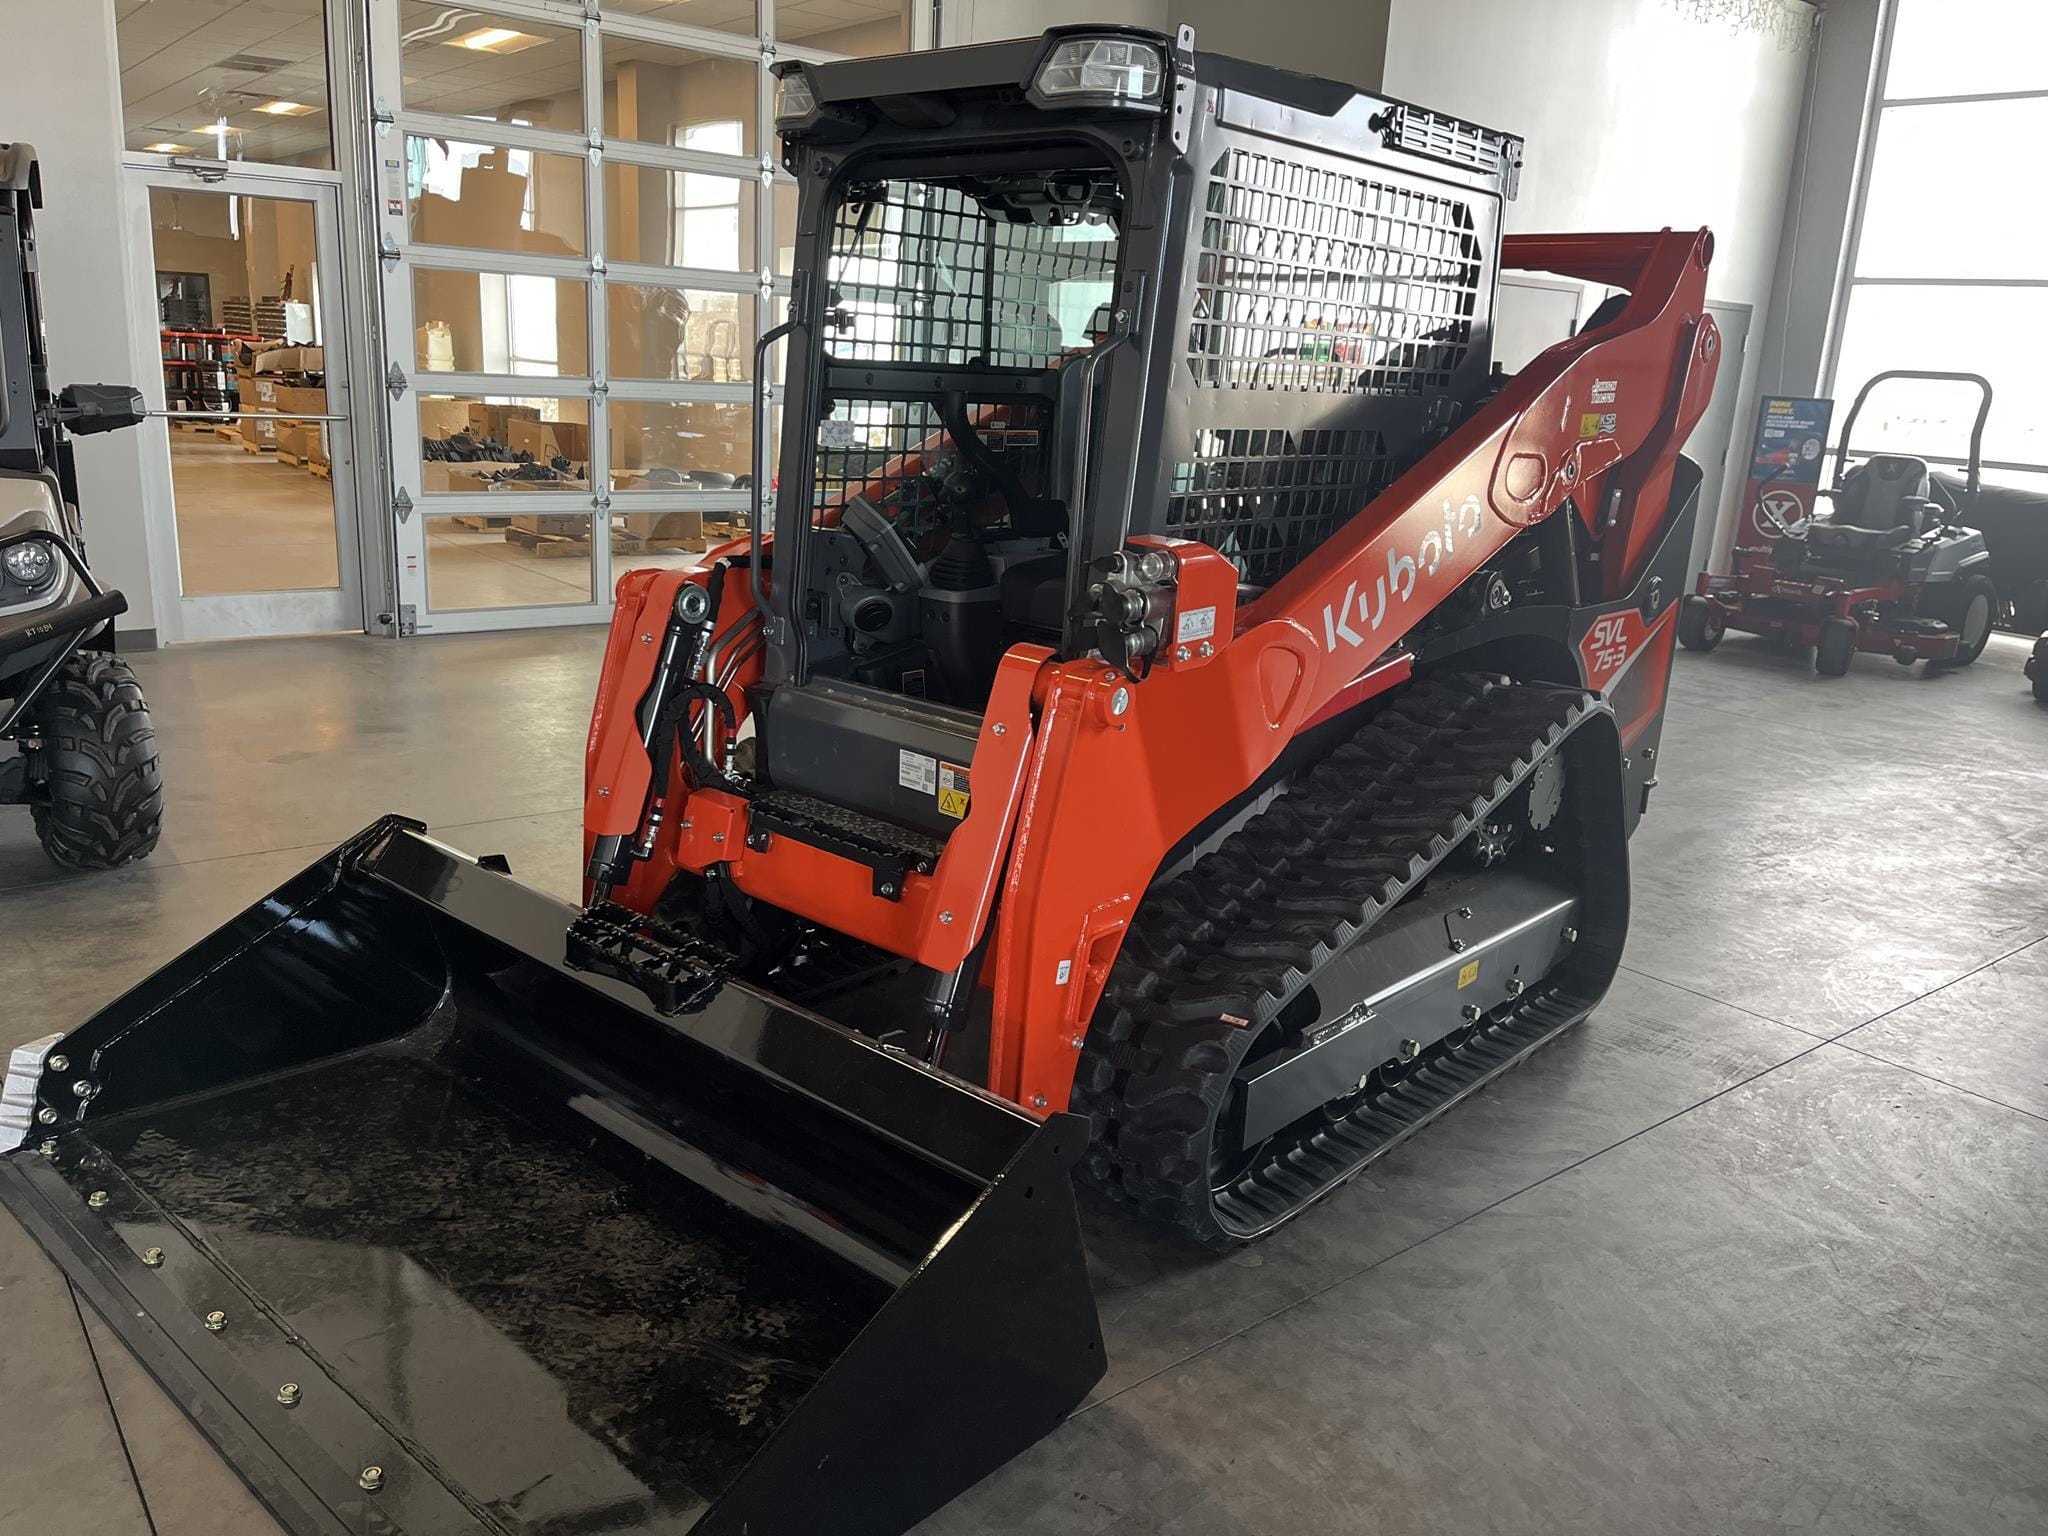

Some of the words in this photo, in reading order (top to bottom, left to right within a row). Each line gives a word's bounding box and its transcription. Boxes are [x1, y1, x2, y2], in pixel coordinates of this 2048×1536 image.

[1323, 494, 1482, 653] Kubota
[1590, 617, 1628, 650] SVL
[1593, 645, 1627, 673] 75-3
